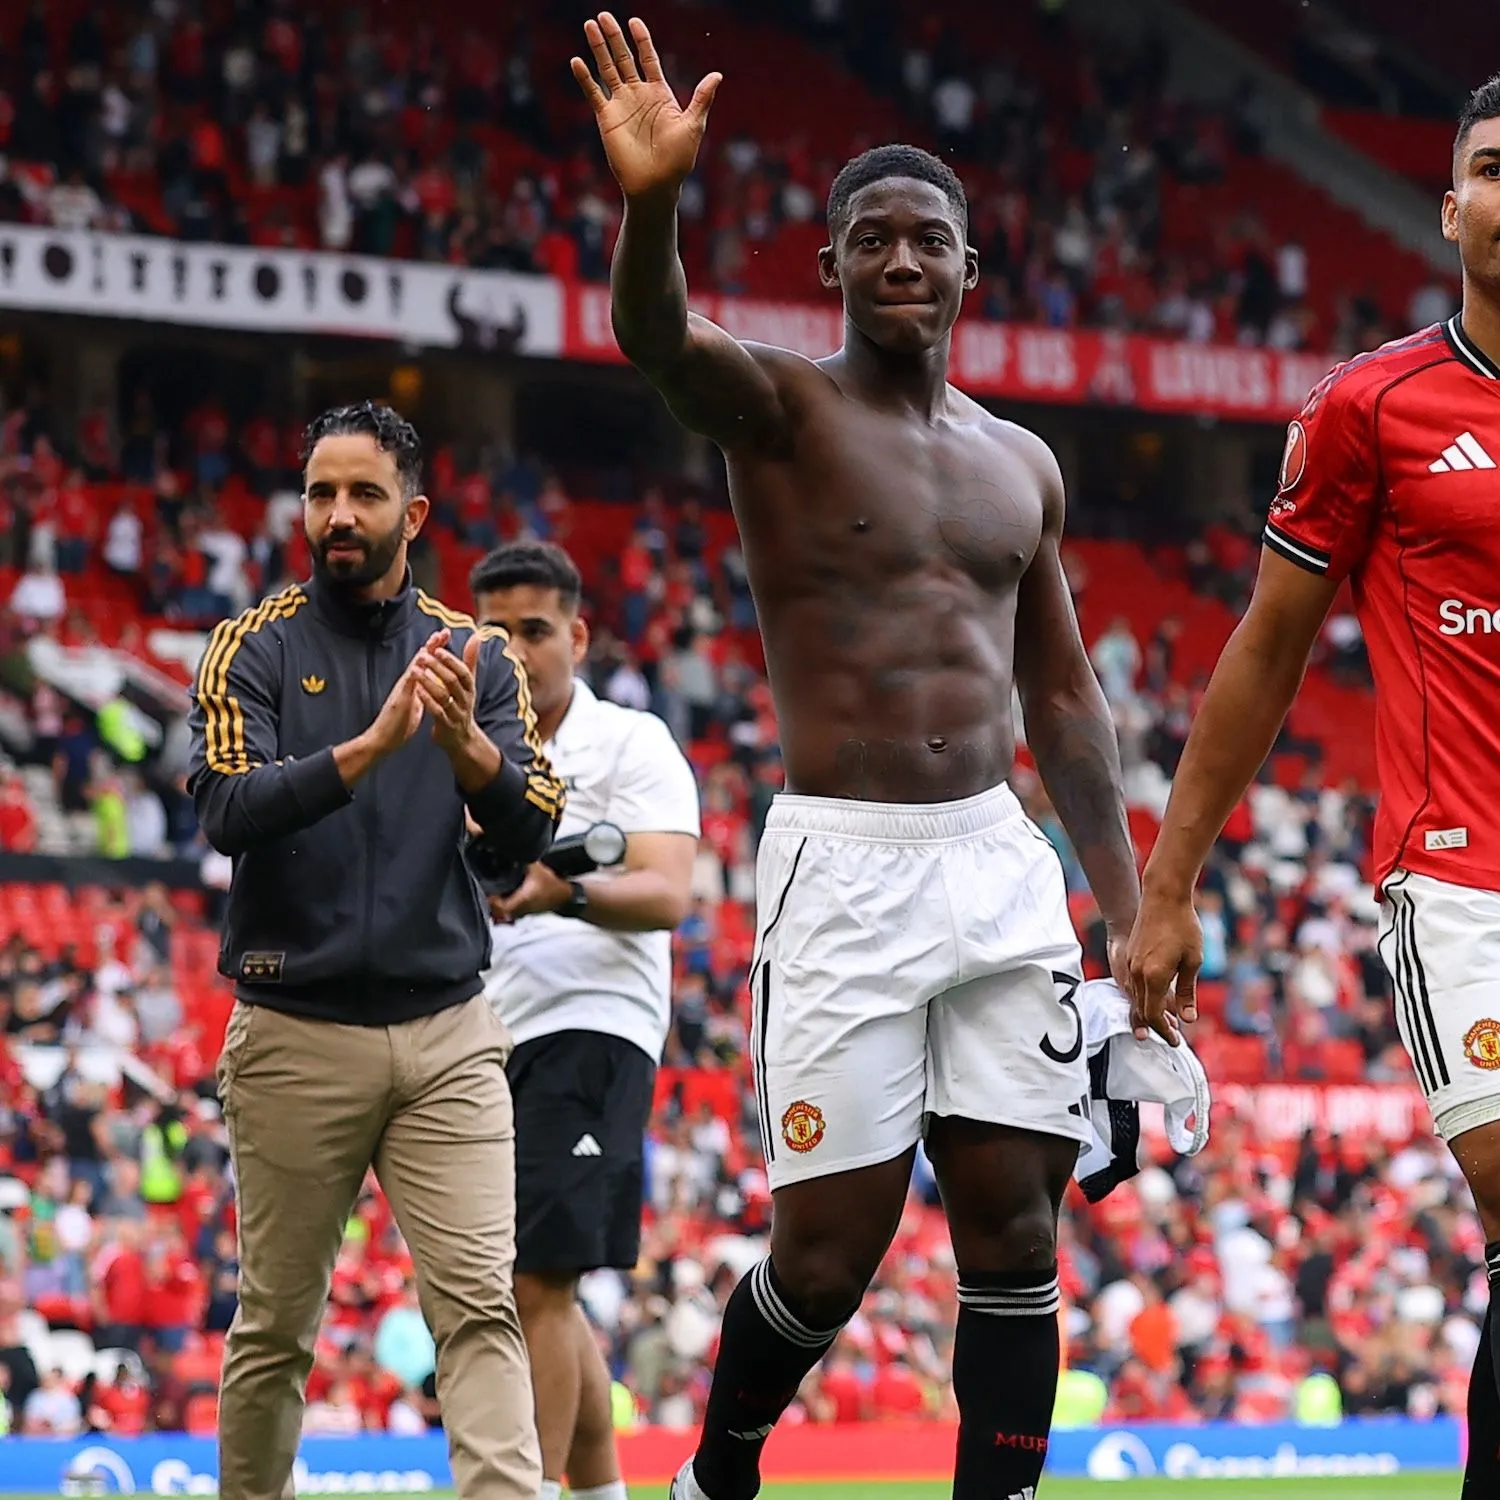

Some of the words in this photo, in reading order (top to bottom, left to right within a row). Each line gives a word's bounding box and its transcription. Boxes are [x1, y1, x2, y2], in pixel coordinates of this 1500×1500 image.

[1039, 970, 1083, 1064] 3
[791, 1138, 818, 1150] UNITED
[993, 1431, 1047, 1453] MUF
